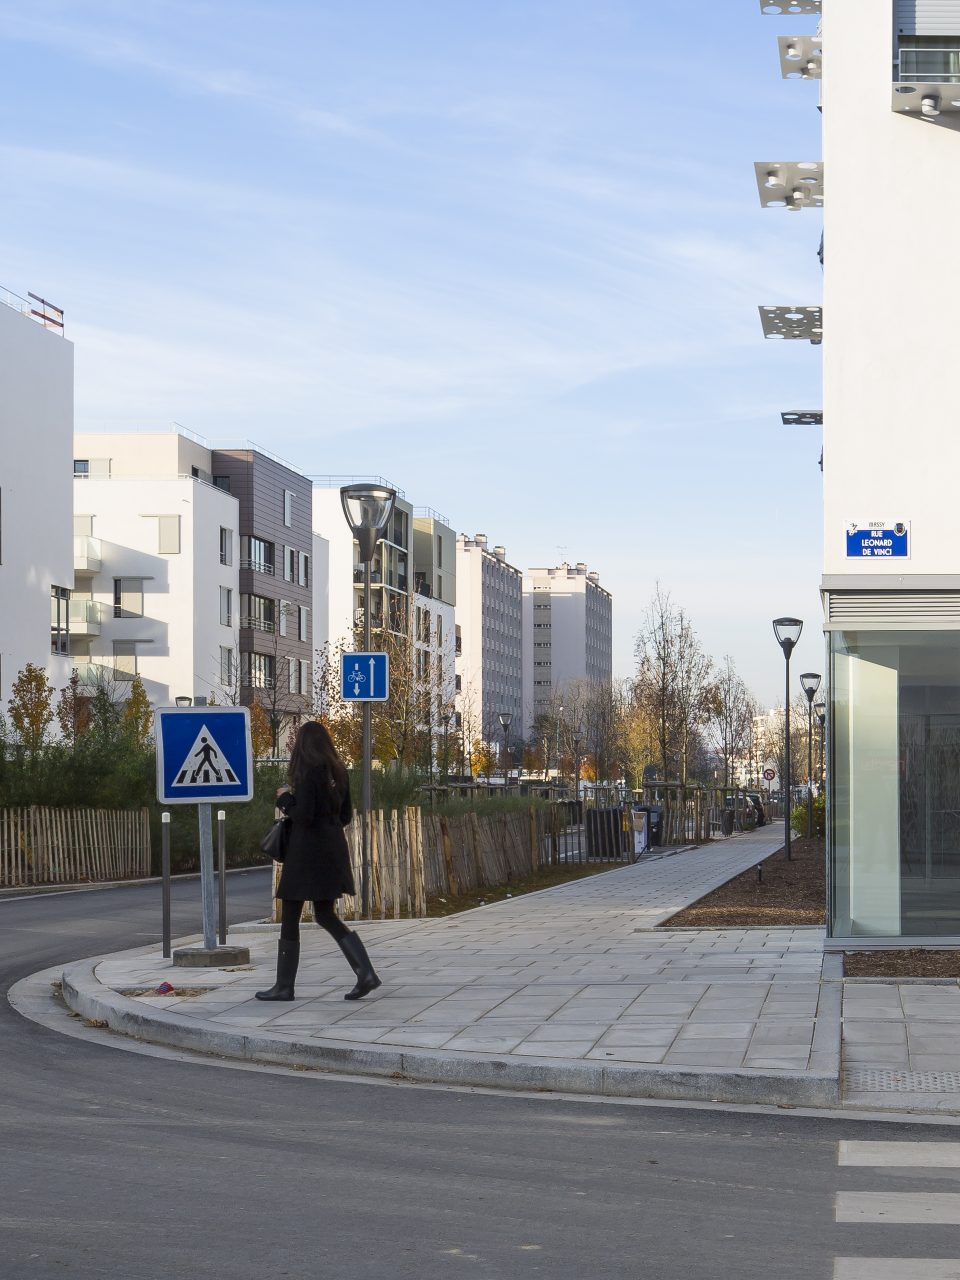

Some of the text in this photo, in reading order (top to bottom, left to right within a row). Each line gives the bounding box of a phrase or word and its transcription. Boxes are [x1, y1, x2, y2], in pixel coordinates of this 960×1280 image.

[870, 530, 883, 538] RUE
[861, 539, 893, 547] LEONARD
[862, 548, 892, 556] DE VINCI
